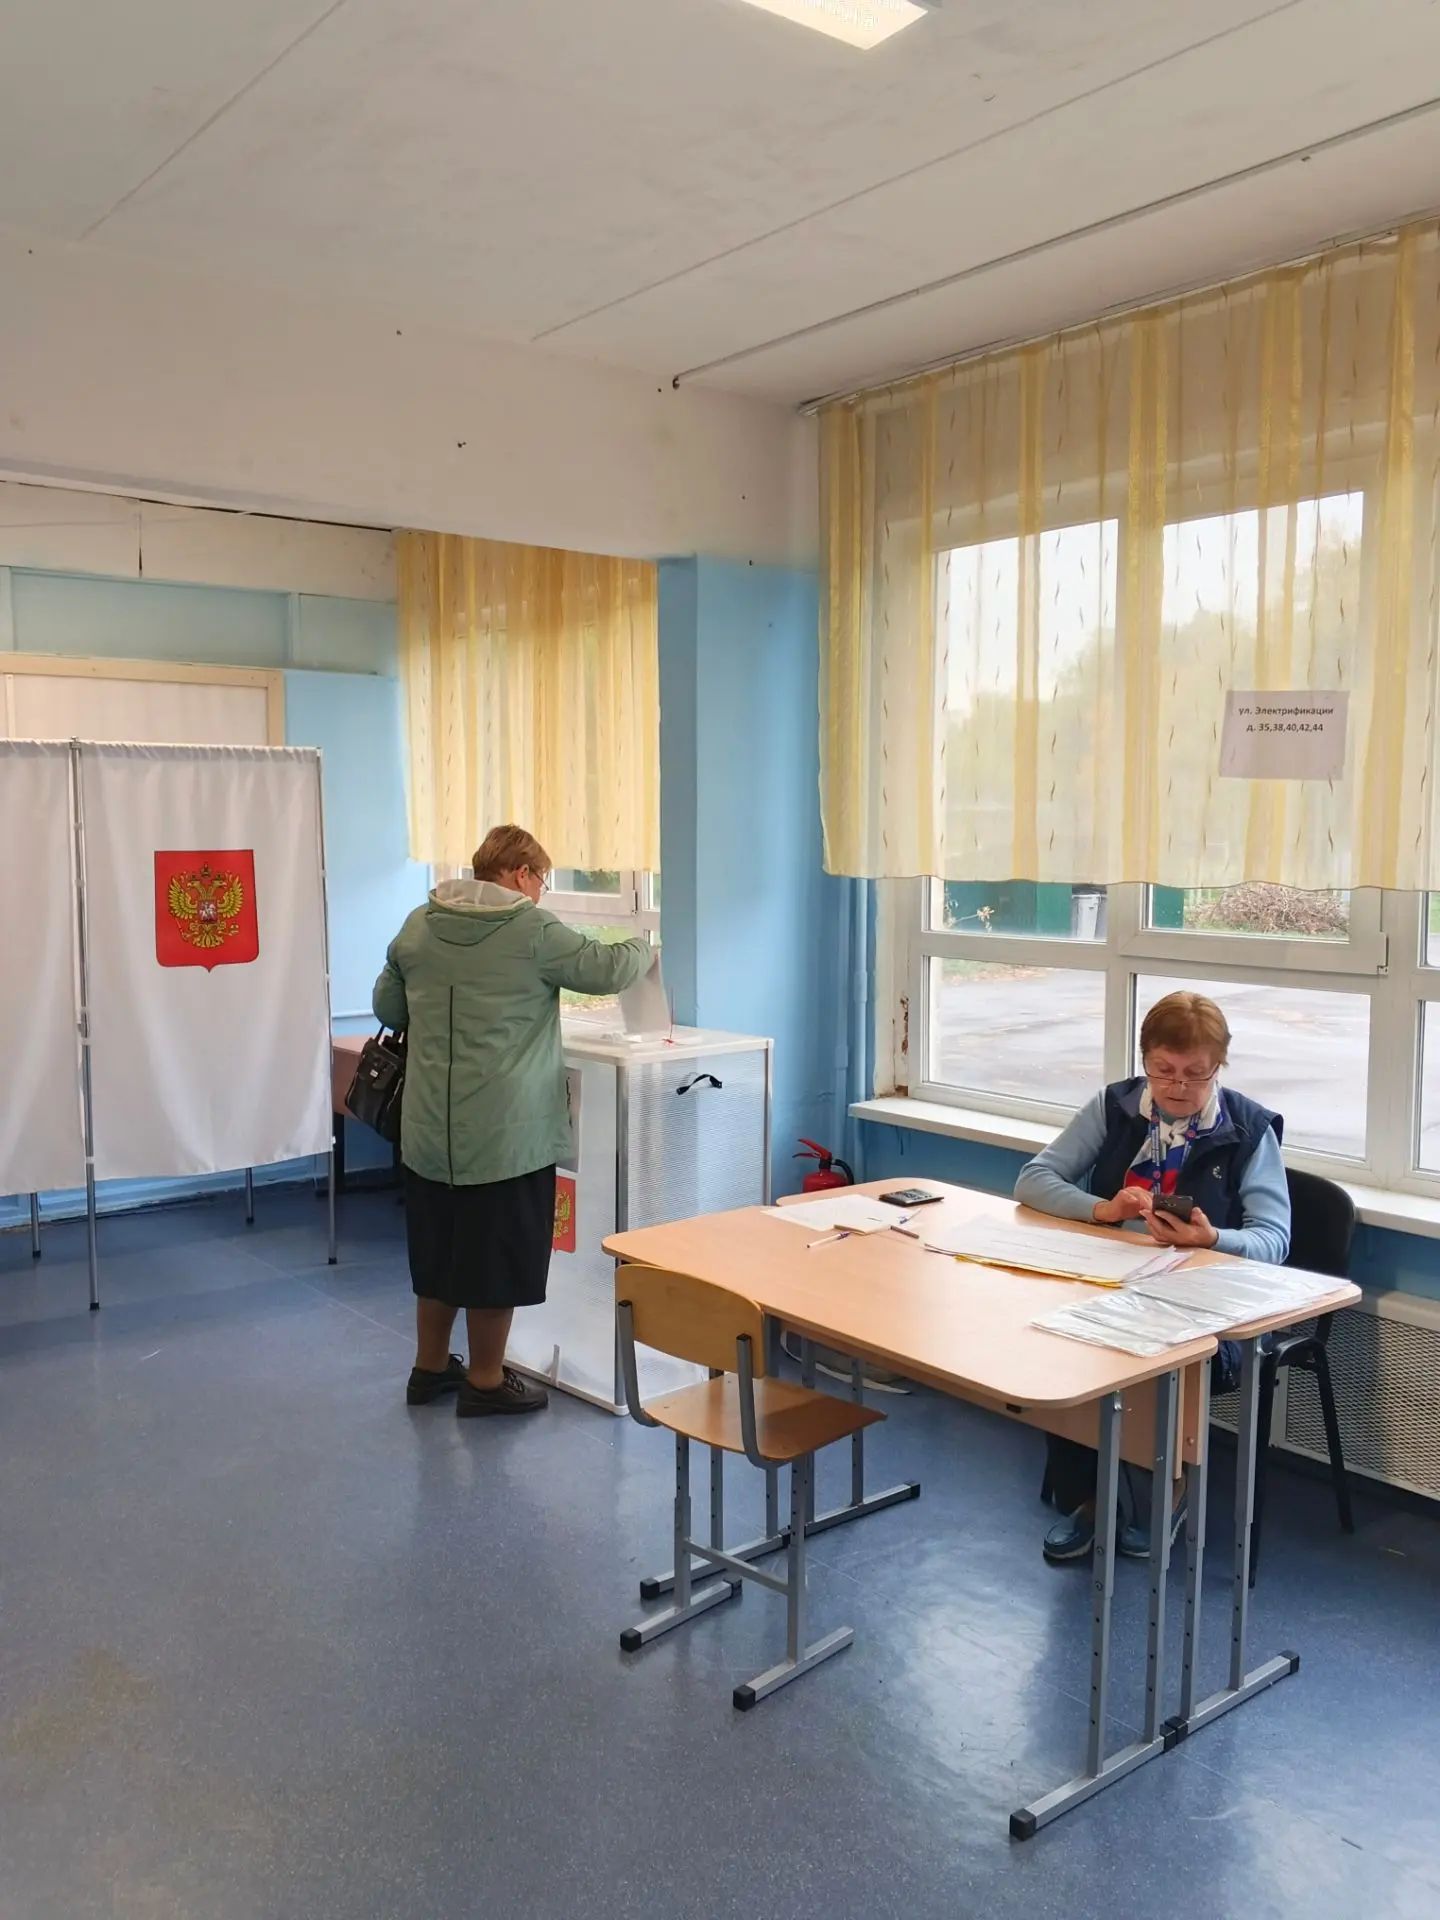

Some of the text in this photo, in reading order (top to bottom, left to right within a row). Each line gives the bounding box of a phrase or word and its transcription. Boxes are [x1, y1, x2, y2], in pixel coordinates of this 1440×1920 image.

[1238, 706, 1334, 716] ул. Электрификации
[1246, 723, 1324, 733] д. 35,38,40,42,44
